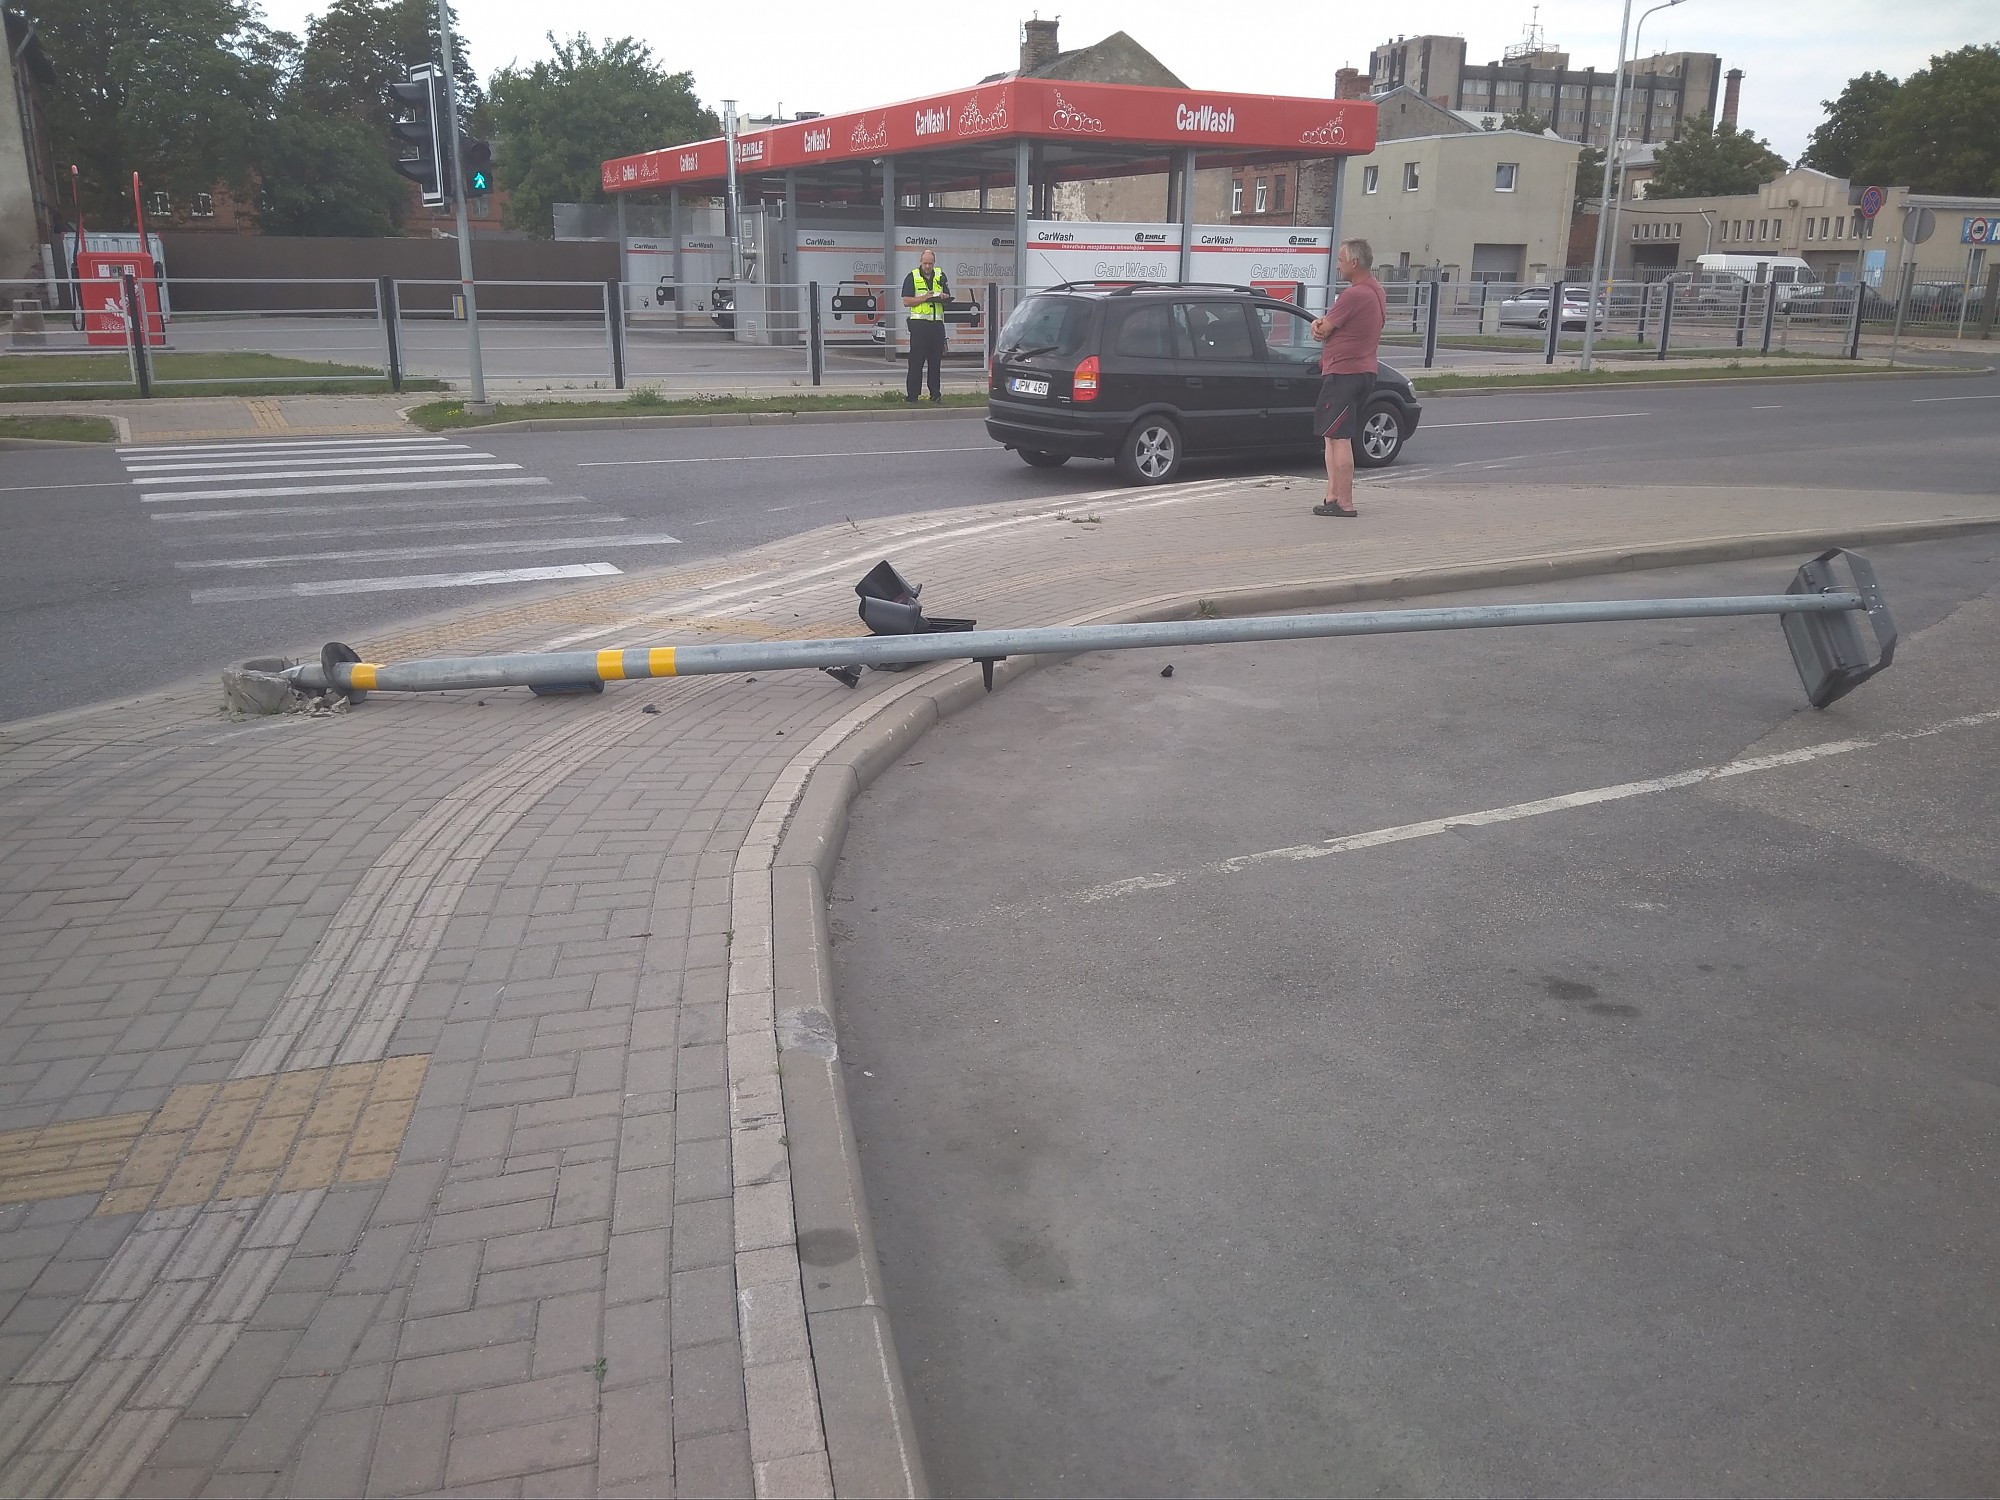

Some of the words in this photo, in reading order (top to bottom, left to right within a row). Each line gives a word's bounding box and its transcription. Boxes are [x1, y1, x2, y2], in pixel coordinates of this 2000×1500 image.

[915, 107, 945, 136] CarWash
[946, 105, 951, 131] 1
[1177, 103, 1234, 132] CarWash
[804, 128, 826, 153] CarWash
[826, 126, 831, 149] 2
[742, 140, 763, 156] EHRLE
[680, 153, 694, 172] CarWash
[695, 152, 698, 171] 3
[622, 164, 635, 181] CarWash
[635, 164, 637, 180] 4
[805, 238, 835, 246] CarWash
[905, 236, 938, 245] CarWash
[1038, 231, 1074, 242] CarWash
[1201, 235, 1234, 245] CarWash
[1094, 262, 1168, 278] CarWash
[1250, 264, 1318, 279] CarWash
[1033, 382, 1047, 394] 460
